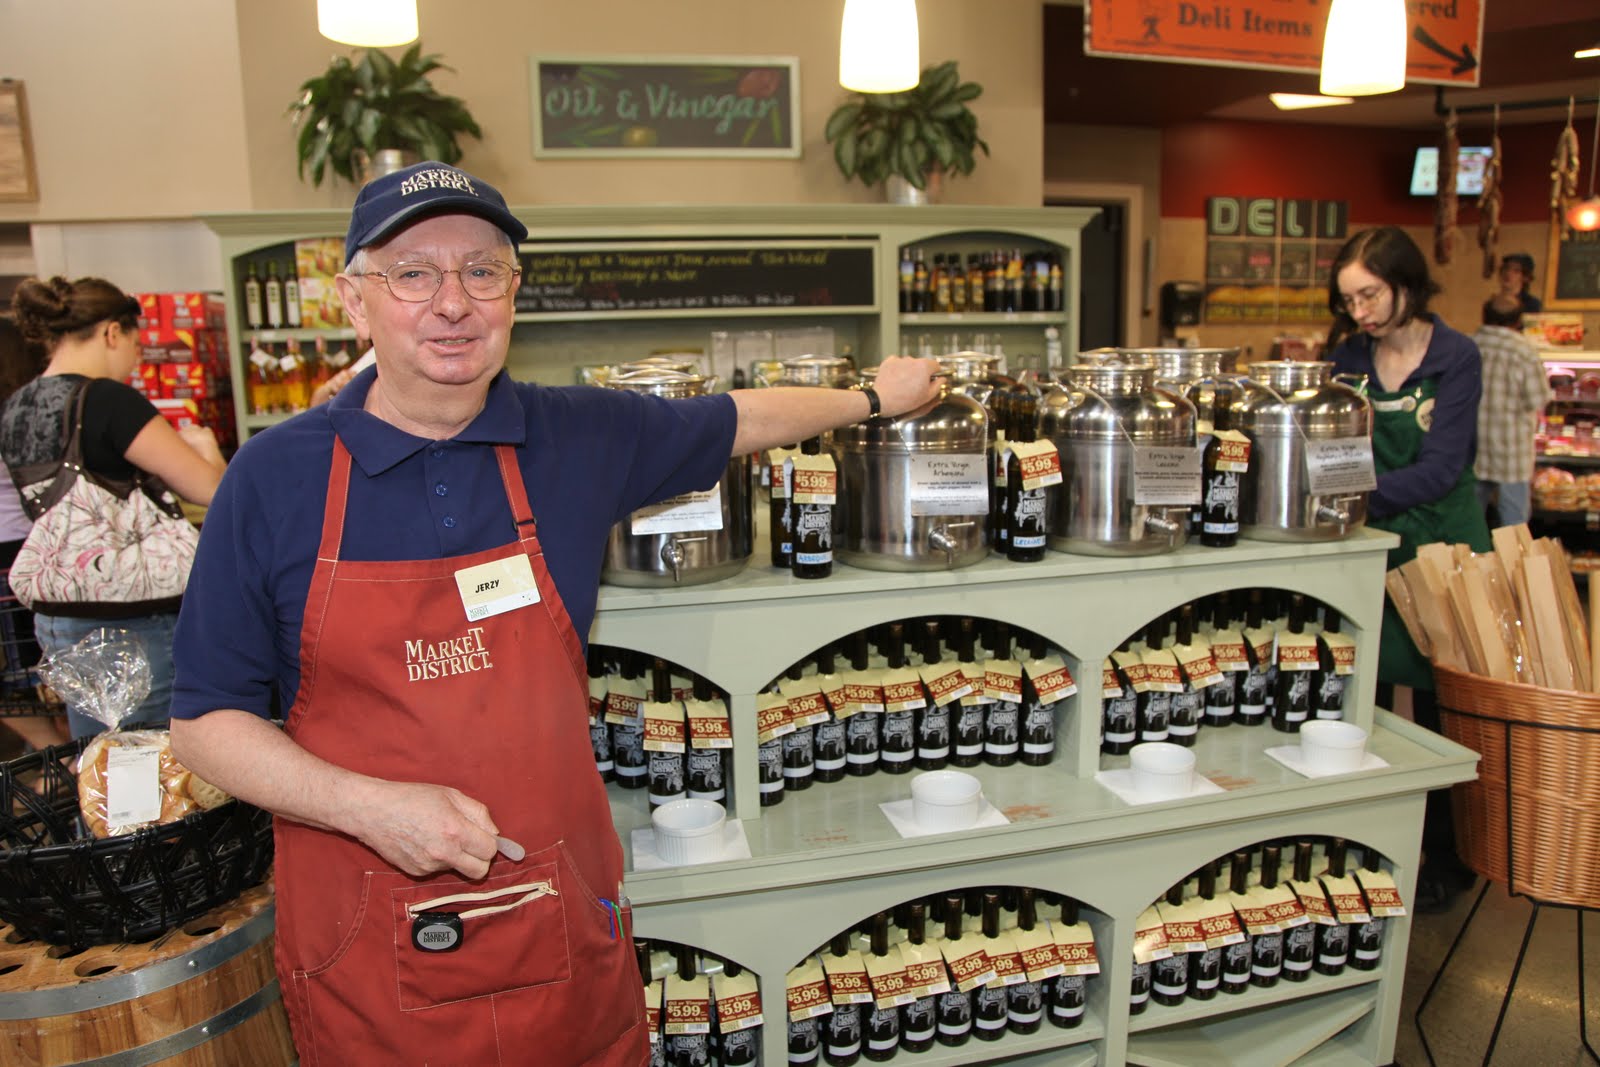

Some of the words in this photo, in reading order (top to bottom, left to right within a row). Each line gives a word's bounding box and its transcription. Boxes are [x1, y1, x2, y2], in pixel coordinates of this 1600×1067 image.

[1178, 3, 1231, 30] Deli
[1244, 9, 1313, 37] Items
[544, 84, 604, 117] Oil
[616, 89, 640, 120] &
[645, 82, 779, 135] Vinegar
[401, 171, 471, 188] MARKET
[401, 180, 475, 196] DISTRICT
[1212, 197, 1337, 236] DELI
[1022, 458, 1052, 473] $5.99
[795, 475, 827, 488] $5.99
[475, 579, 500, 593] JERZY
[405, 627, 486, 664] MARKET
[407, 651, 490, 682] DISTRICT
[930, 676, 959, 693] $5.99
[986, 674, 1015, 688] $5.99
[1034, 674, 1065, 691] $5.99
[845, 687, 875, 699] $5.99
[885, 686, 915, 699] $5.99
[609, 698, 638, 712] $5.99
[789, 698, 817, 713] $5.99
[758, 711, 783, 727] 5.99
[645, 724, 677, 736] $5.99
[691, 722, 722, 733] $5.99
[1167, 926, 1196, 938] $5.99
[1202, 919, 1232, 933] $5.99
[423, 931, 451, 939] MARKET
[1023, 950, 1052, 965] $5.99
[1058, 948, 1088, 960] $5.99
[952, 958, 982, 975] $5.99
[908, 967, 938, 981] $5.99
[831, 978, 861, 988] $5.99
[873, 978, 903, 992] $5.99
[788, 988, 819, 1004] $5.99
[667, 1005, 700, 1017] $5.99
[719, 1000, 751, 1015] $5.99
